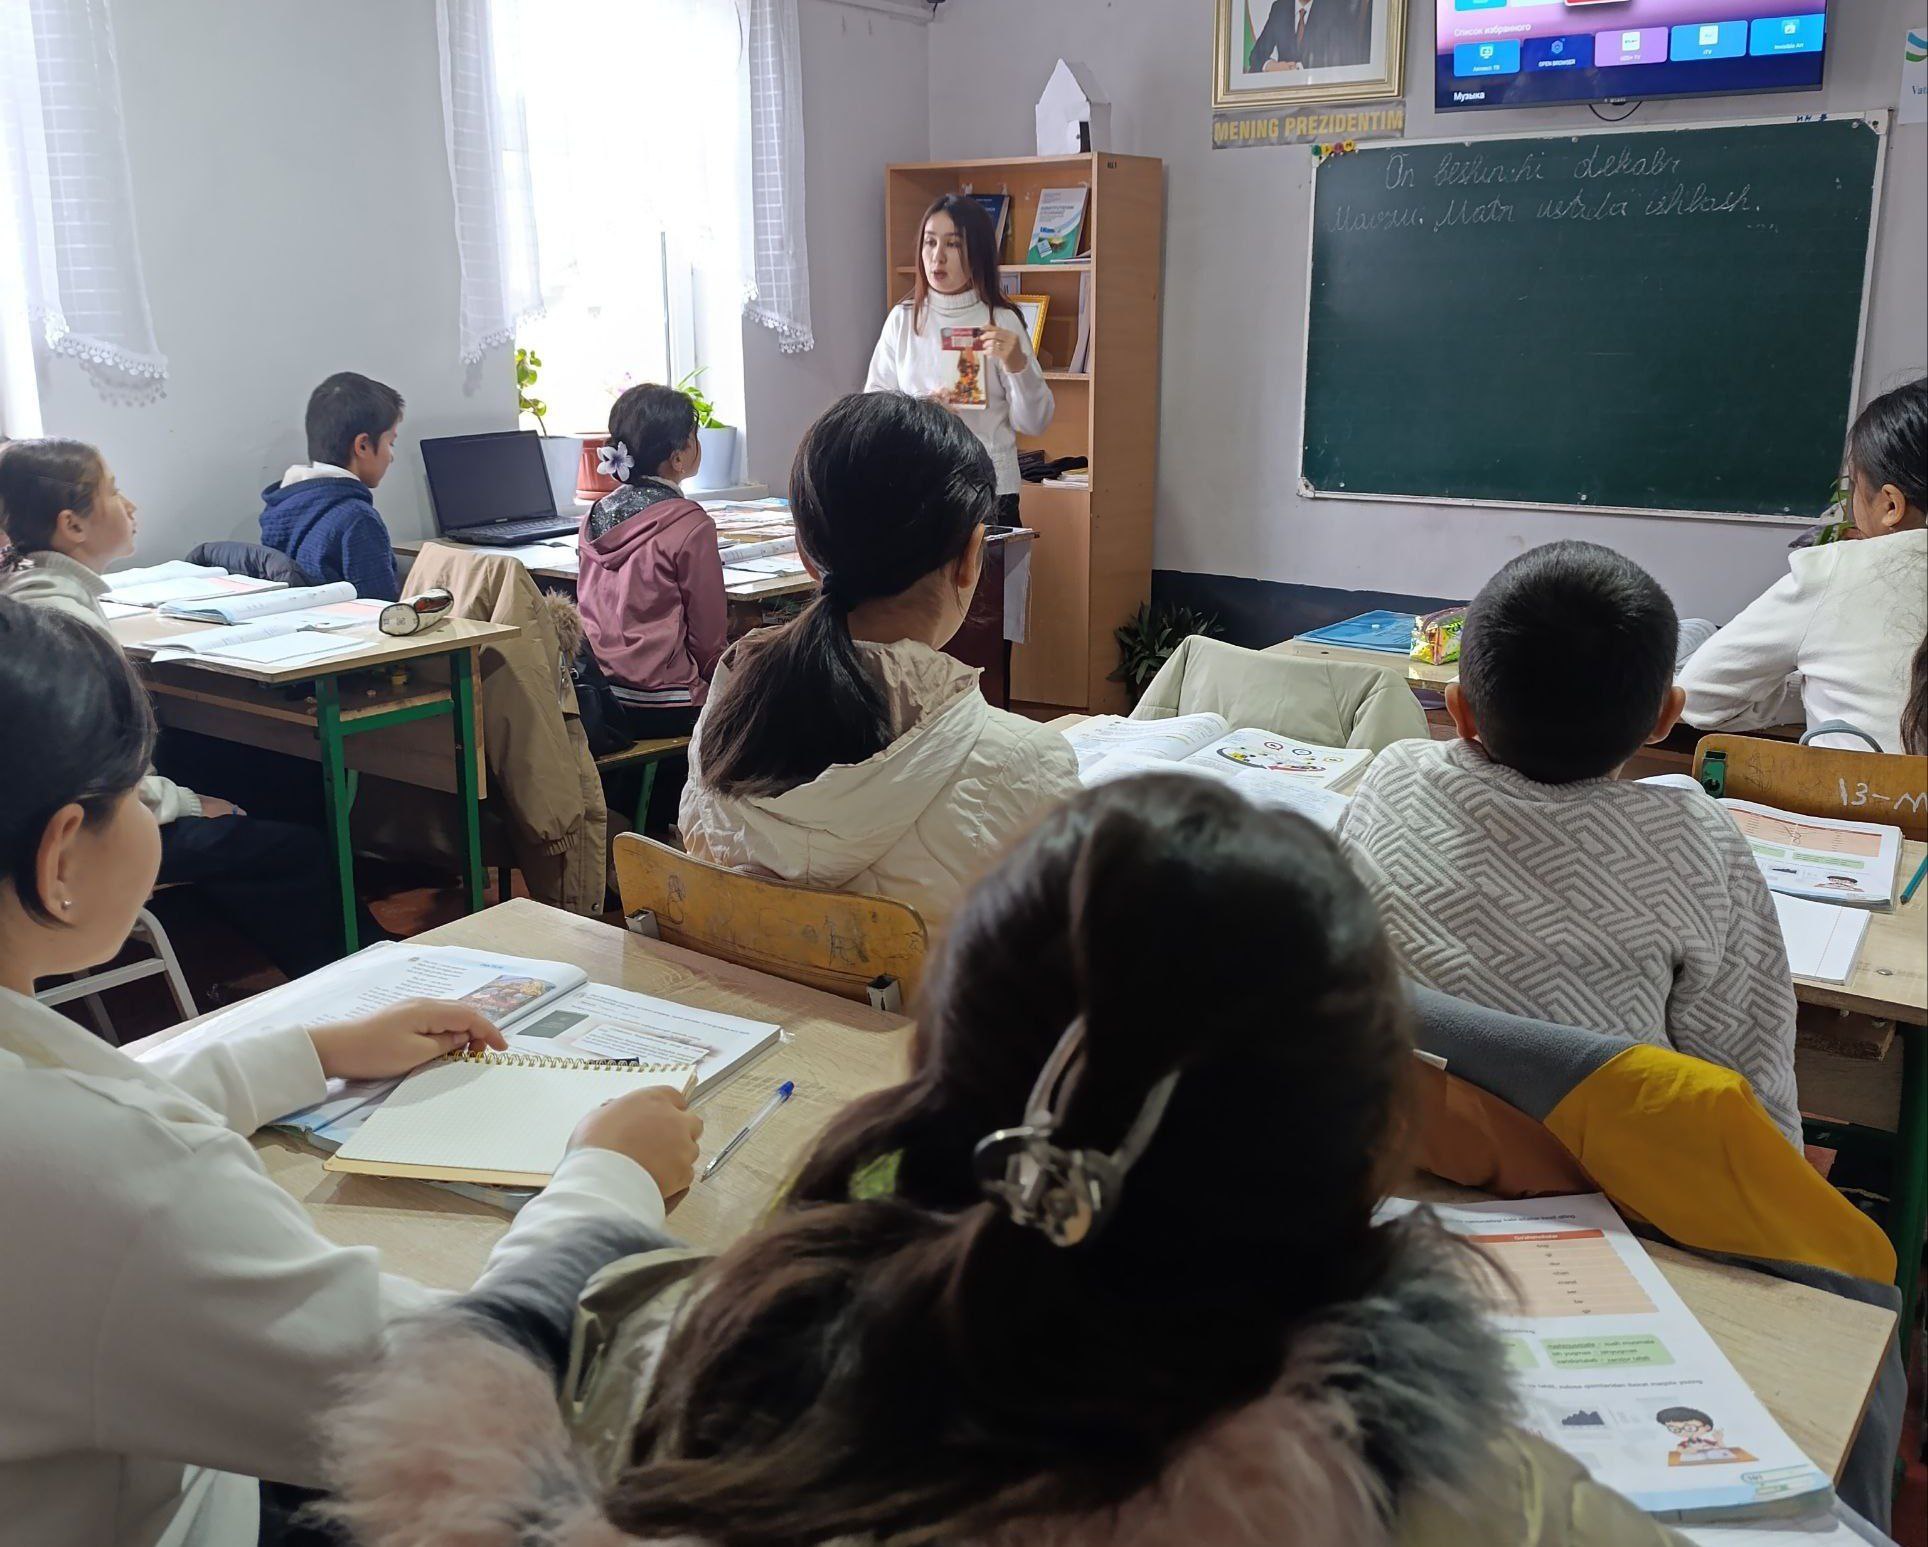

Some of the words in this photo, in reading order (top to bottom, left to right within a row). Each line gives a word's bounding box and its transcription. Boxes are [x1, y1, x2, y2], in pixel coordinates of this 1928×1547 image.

[1454, 26, 1484, 37] Список
[1485, 23, 1531, 35] избранного
[1453, 91, 1485, 102] Музыка
[1214, 118, 1279, 141] MENING
[1284, 110, 1404, 137] PREZIDENTIM
[1574, 144, 1680, 180] dekabr
